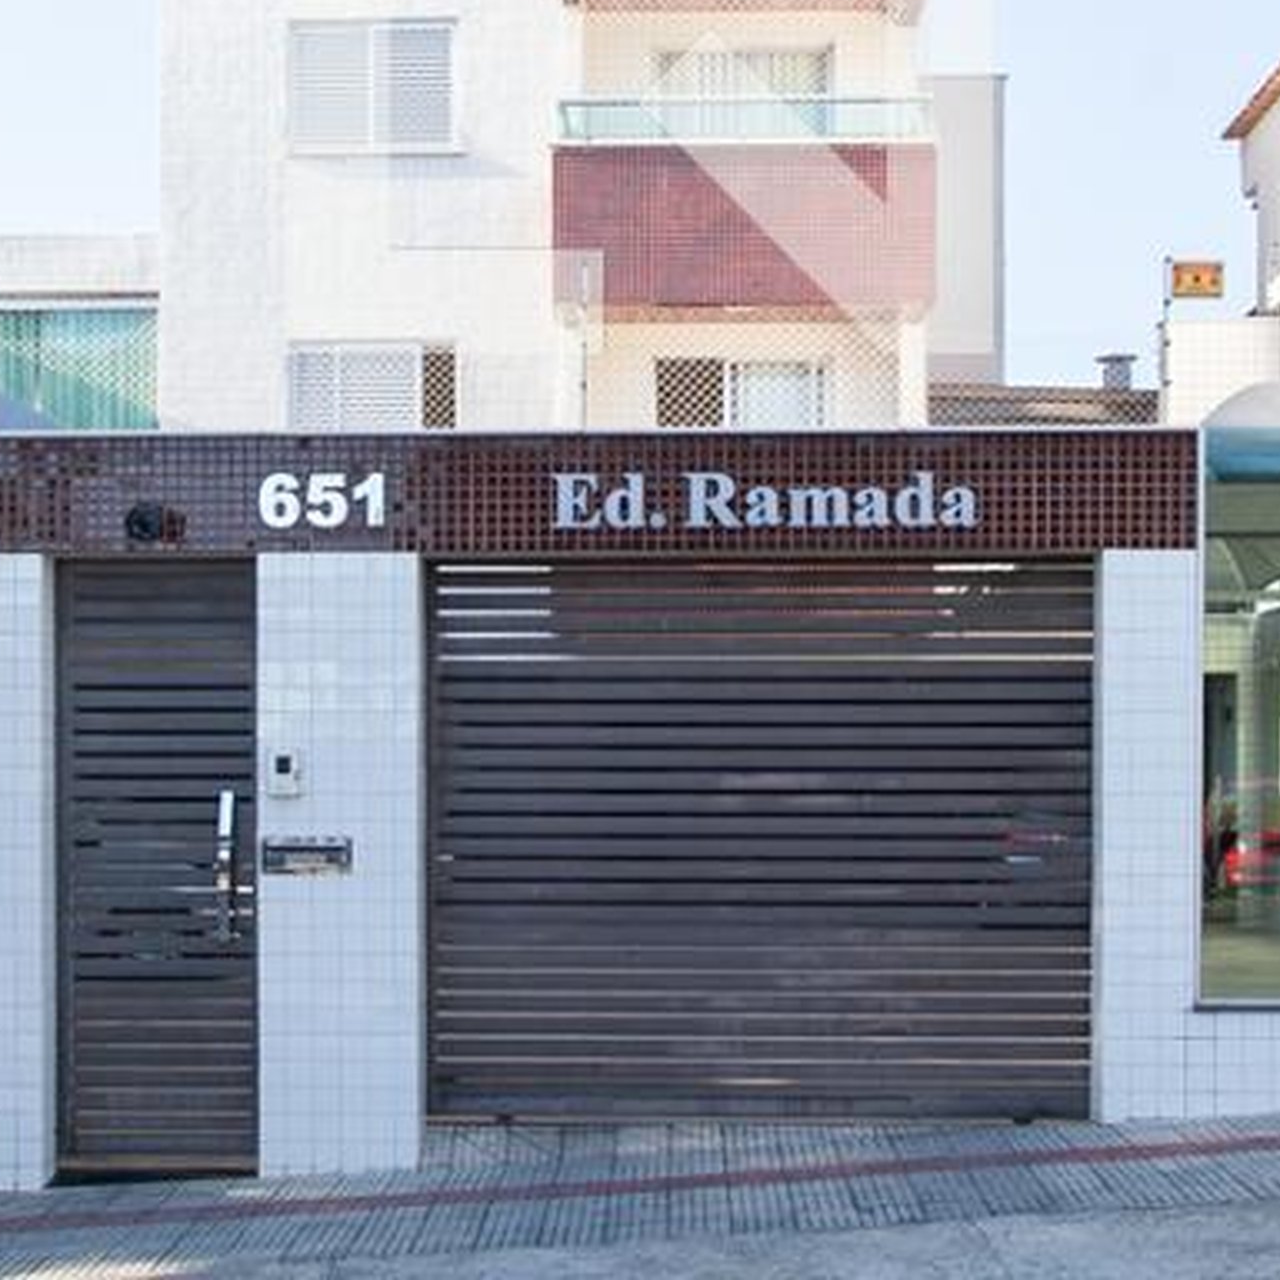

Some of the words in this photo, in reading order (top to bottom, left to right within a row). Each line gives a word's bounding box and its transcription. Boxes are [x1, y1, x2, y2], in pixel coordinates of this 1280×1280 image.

[258, 472, 385, 528] 651
[550, 472, 668, 529] Ed.
[681, 471, 981, 528] Ramada
